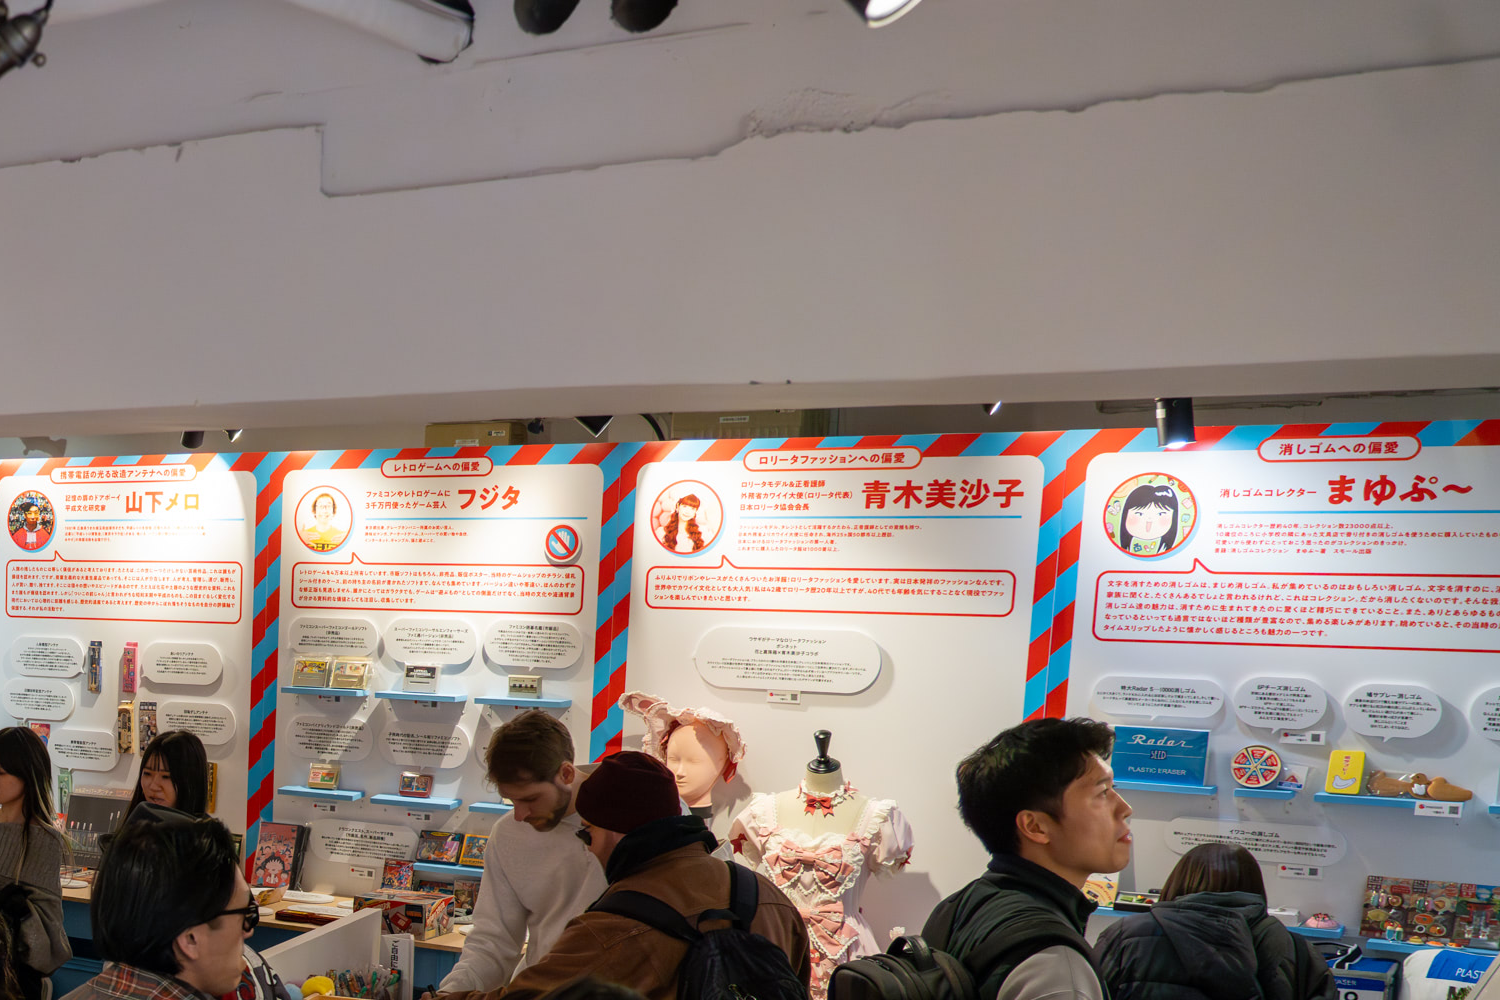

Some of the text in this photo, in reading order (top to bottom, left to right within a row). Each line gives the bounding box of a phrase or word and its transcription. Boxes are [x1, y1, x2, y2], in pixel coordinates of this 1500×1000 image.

[1279, 441, 1399, 456] 消しゴムへの偏愛
[759, 452, 905, 465] ロリータファッションへの偏愛
[394, 461, 480, 472] レトロゲームへの偏愛
[60, 468, 186, 479] 携帯電話の光る改造アンテナへの偏愛
[366, 485, 520, 510] ファミコンやレトロゲームに フジタ
[862, 479, 1024, 509] 青木美沙子
[1220, 488, 1317, 498] 消しゴムコレクター
[125, 491, 199, 513] 山下メロ
[365, 501, 447, 509] 3千万円使ったゲーム芸人
[740, 503, 809, 511] 日本ロリータ協会会長
[1127, 734, 1193, 748] Radar
[1150, 750, 1167, 760] SEED
[1128, 766, 1186, 775] PLASTIC ERASER
[1455, 968, 1486, 979] PLAST
